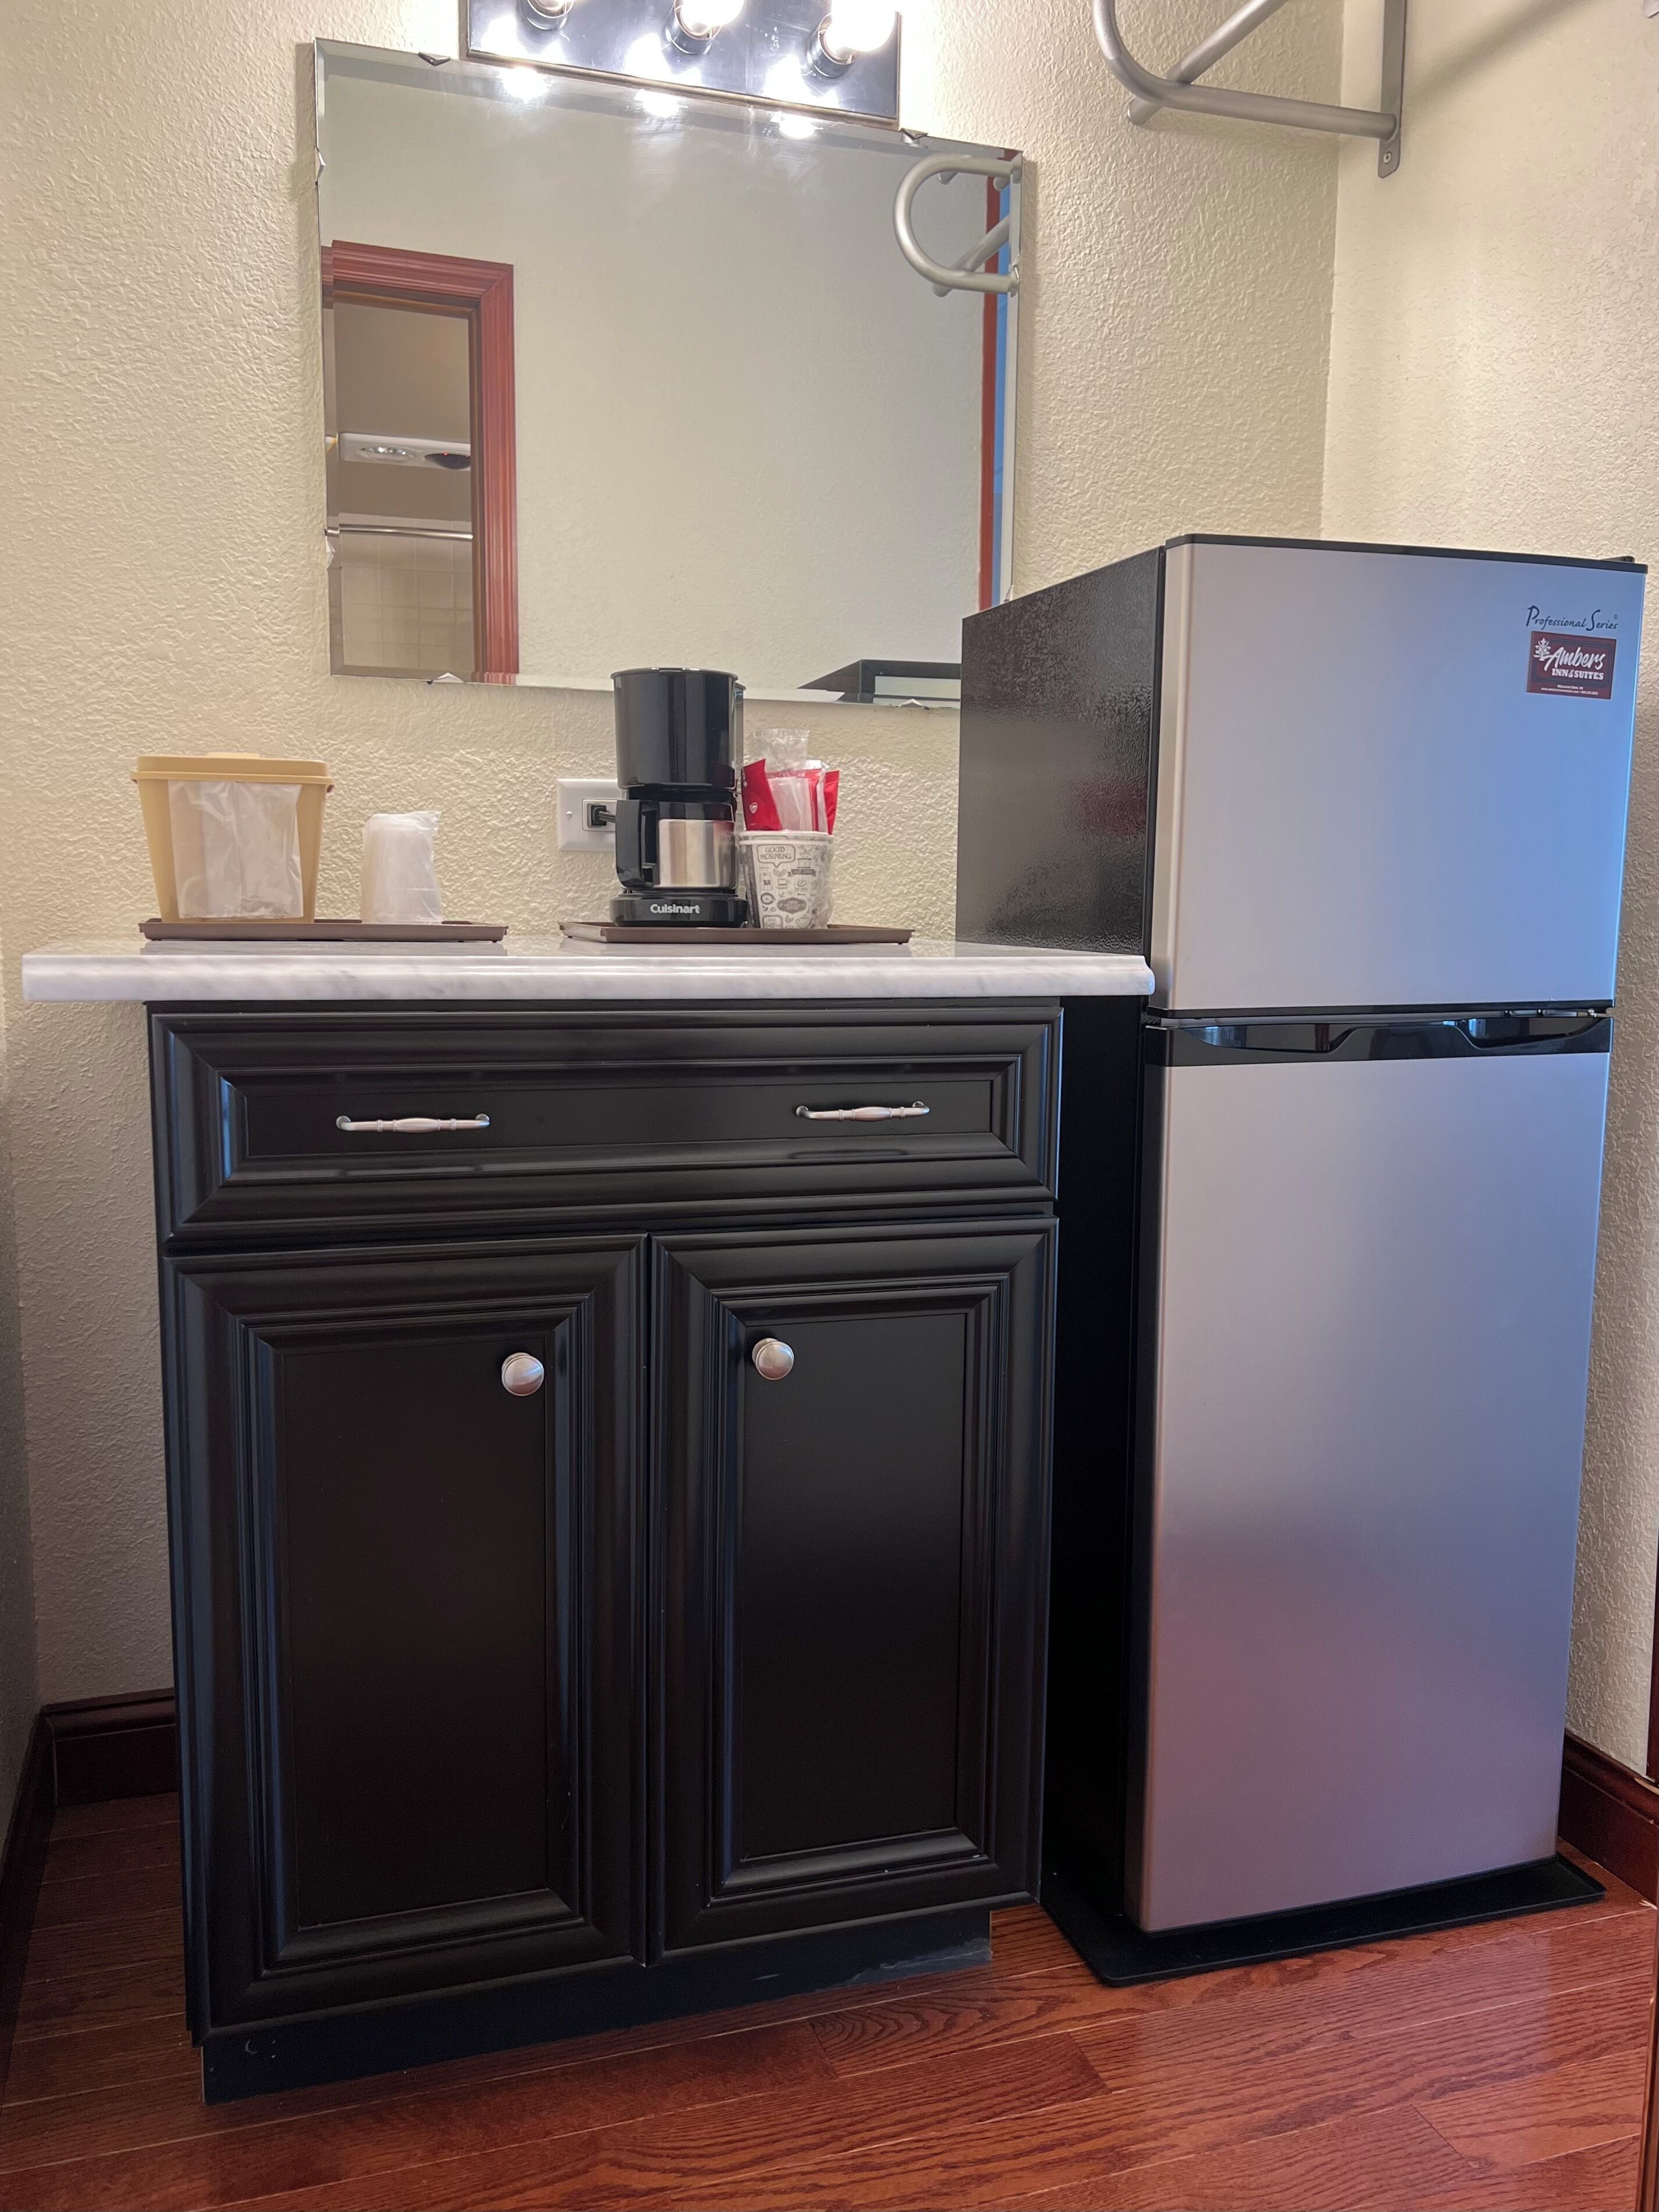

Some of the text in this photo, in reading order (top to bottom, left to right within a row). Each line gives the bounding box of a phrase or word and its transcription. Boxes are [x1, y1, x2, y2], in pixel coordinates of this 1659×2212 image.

[1526, 605, 1586, 630] Professional
[1544, 647, 1606, 671] Ambers
[650, 904, 700, 914] Cuisinart
